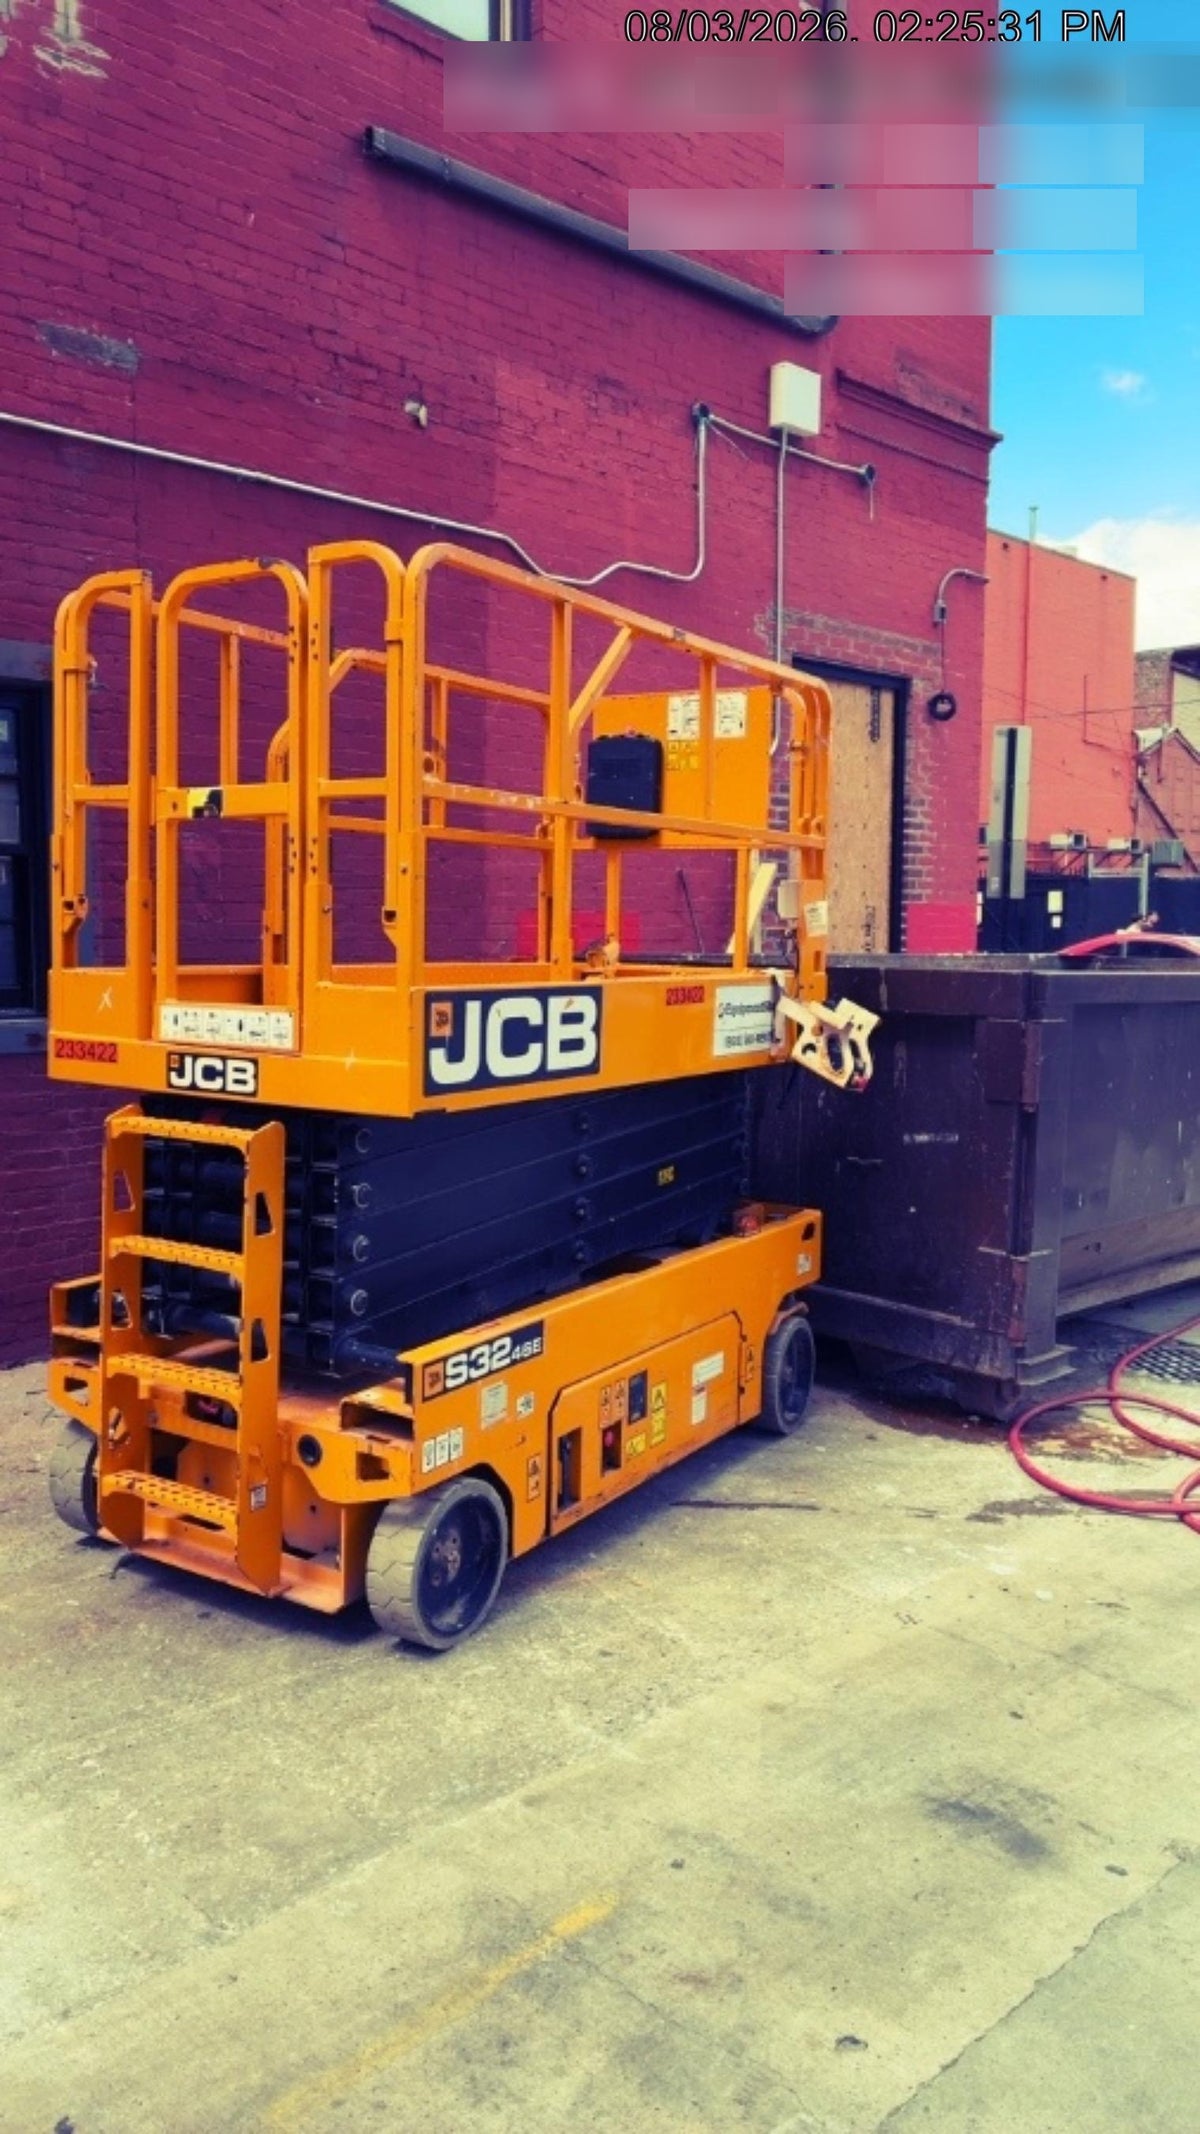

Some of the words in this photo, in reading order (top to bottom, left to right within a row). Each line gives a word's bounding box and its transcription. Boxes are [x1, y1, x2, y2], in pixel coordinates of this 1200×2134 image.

[54, 1038, 118, 1063] 233422
[429, 996, 597, 1084] JCB
[169, 1055, 255, 1093] JCB
